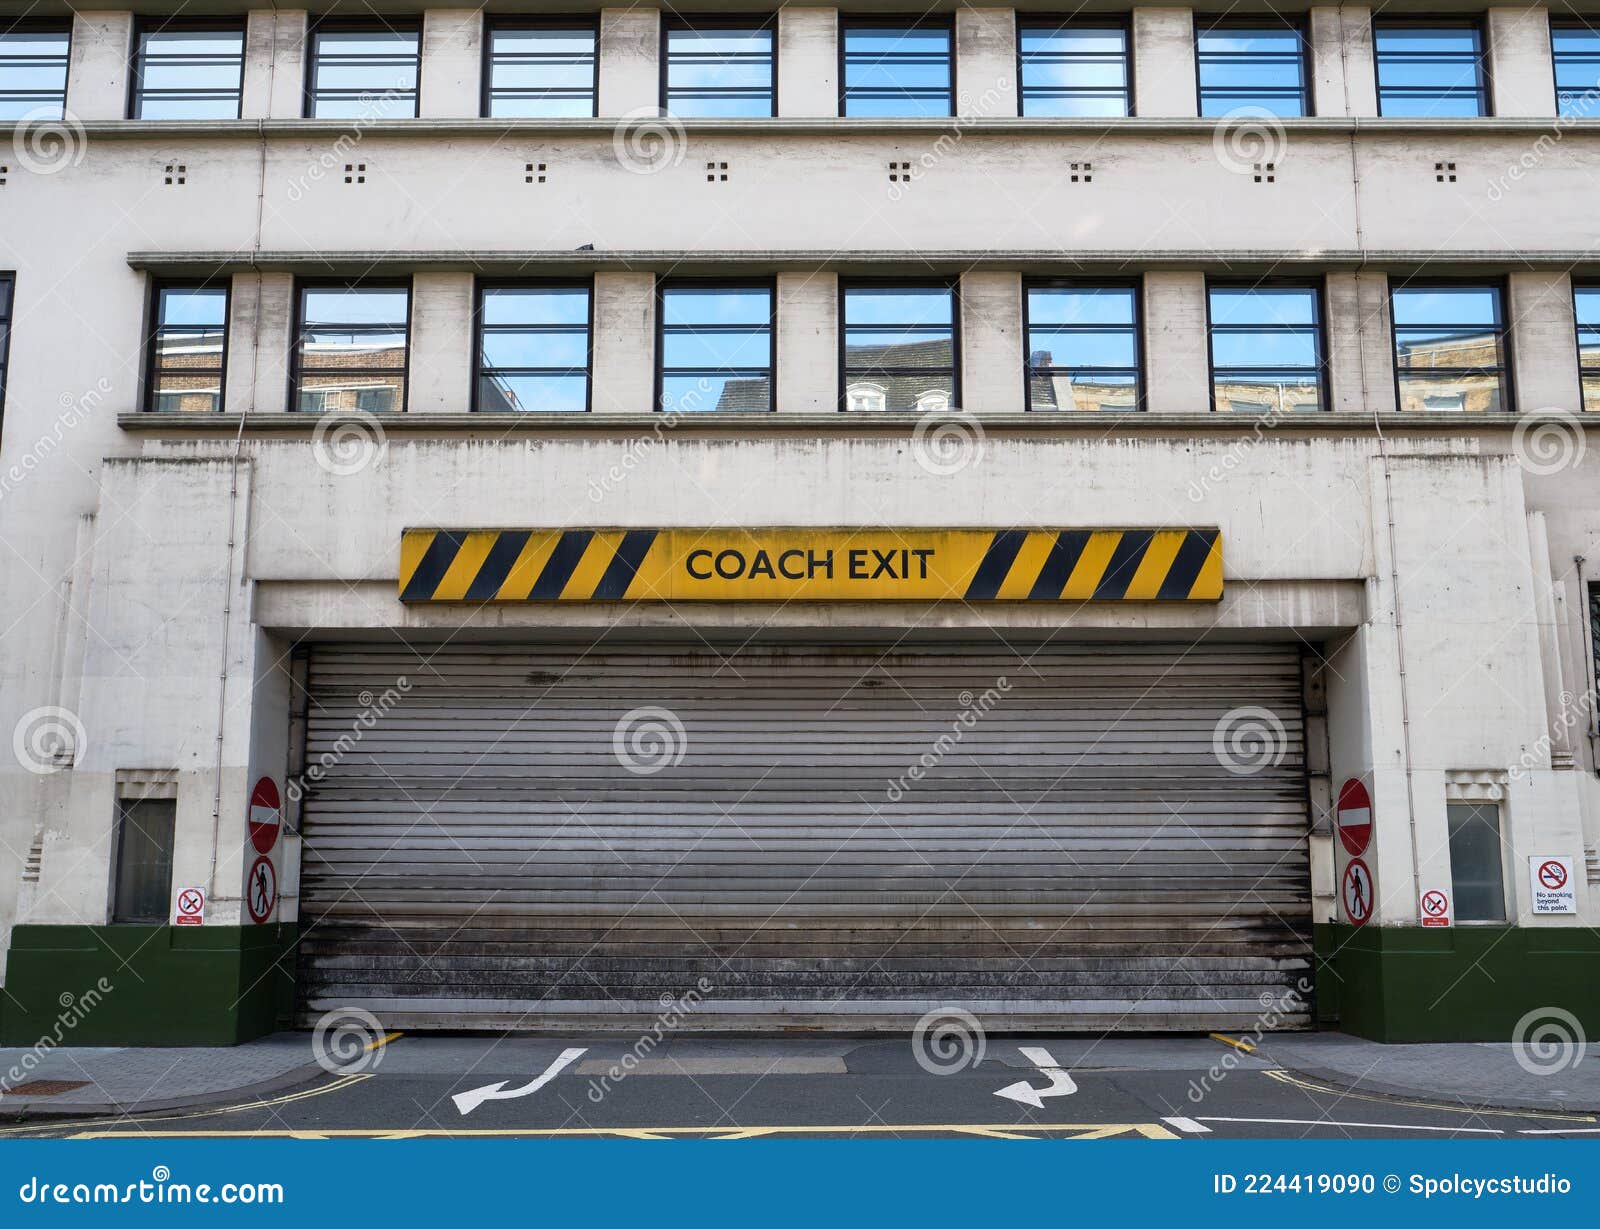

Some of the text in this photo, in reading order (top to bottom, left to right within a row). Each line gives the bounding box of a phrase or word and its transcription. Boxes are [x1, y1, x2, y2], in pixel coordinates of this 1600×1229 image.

[685, 549, 936, 580] COACH EXIT
[1536, 898, 1560, 906] beyond
